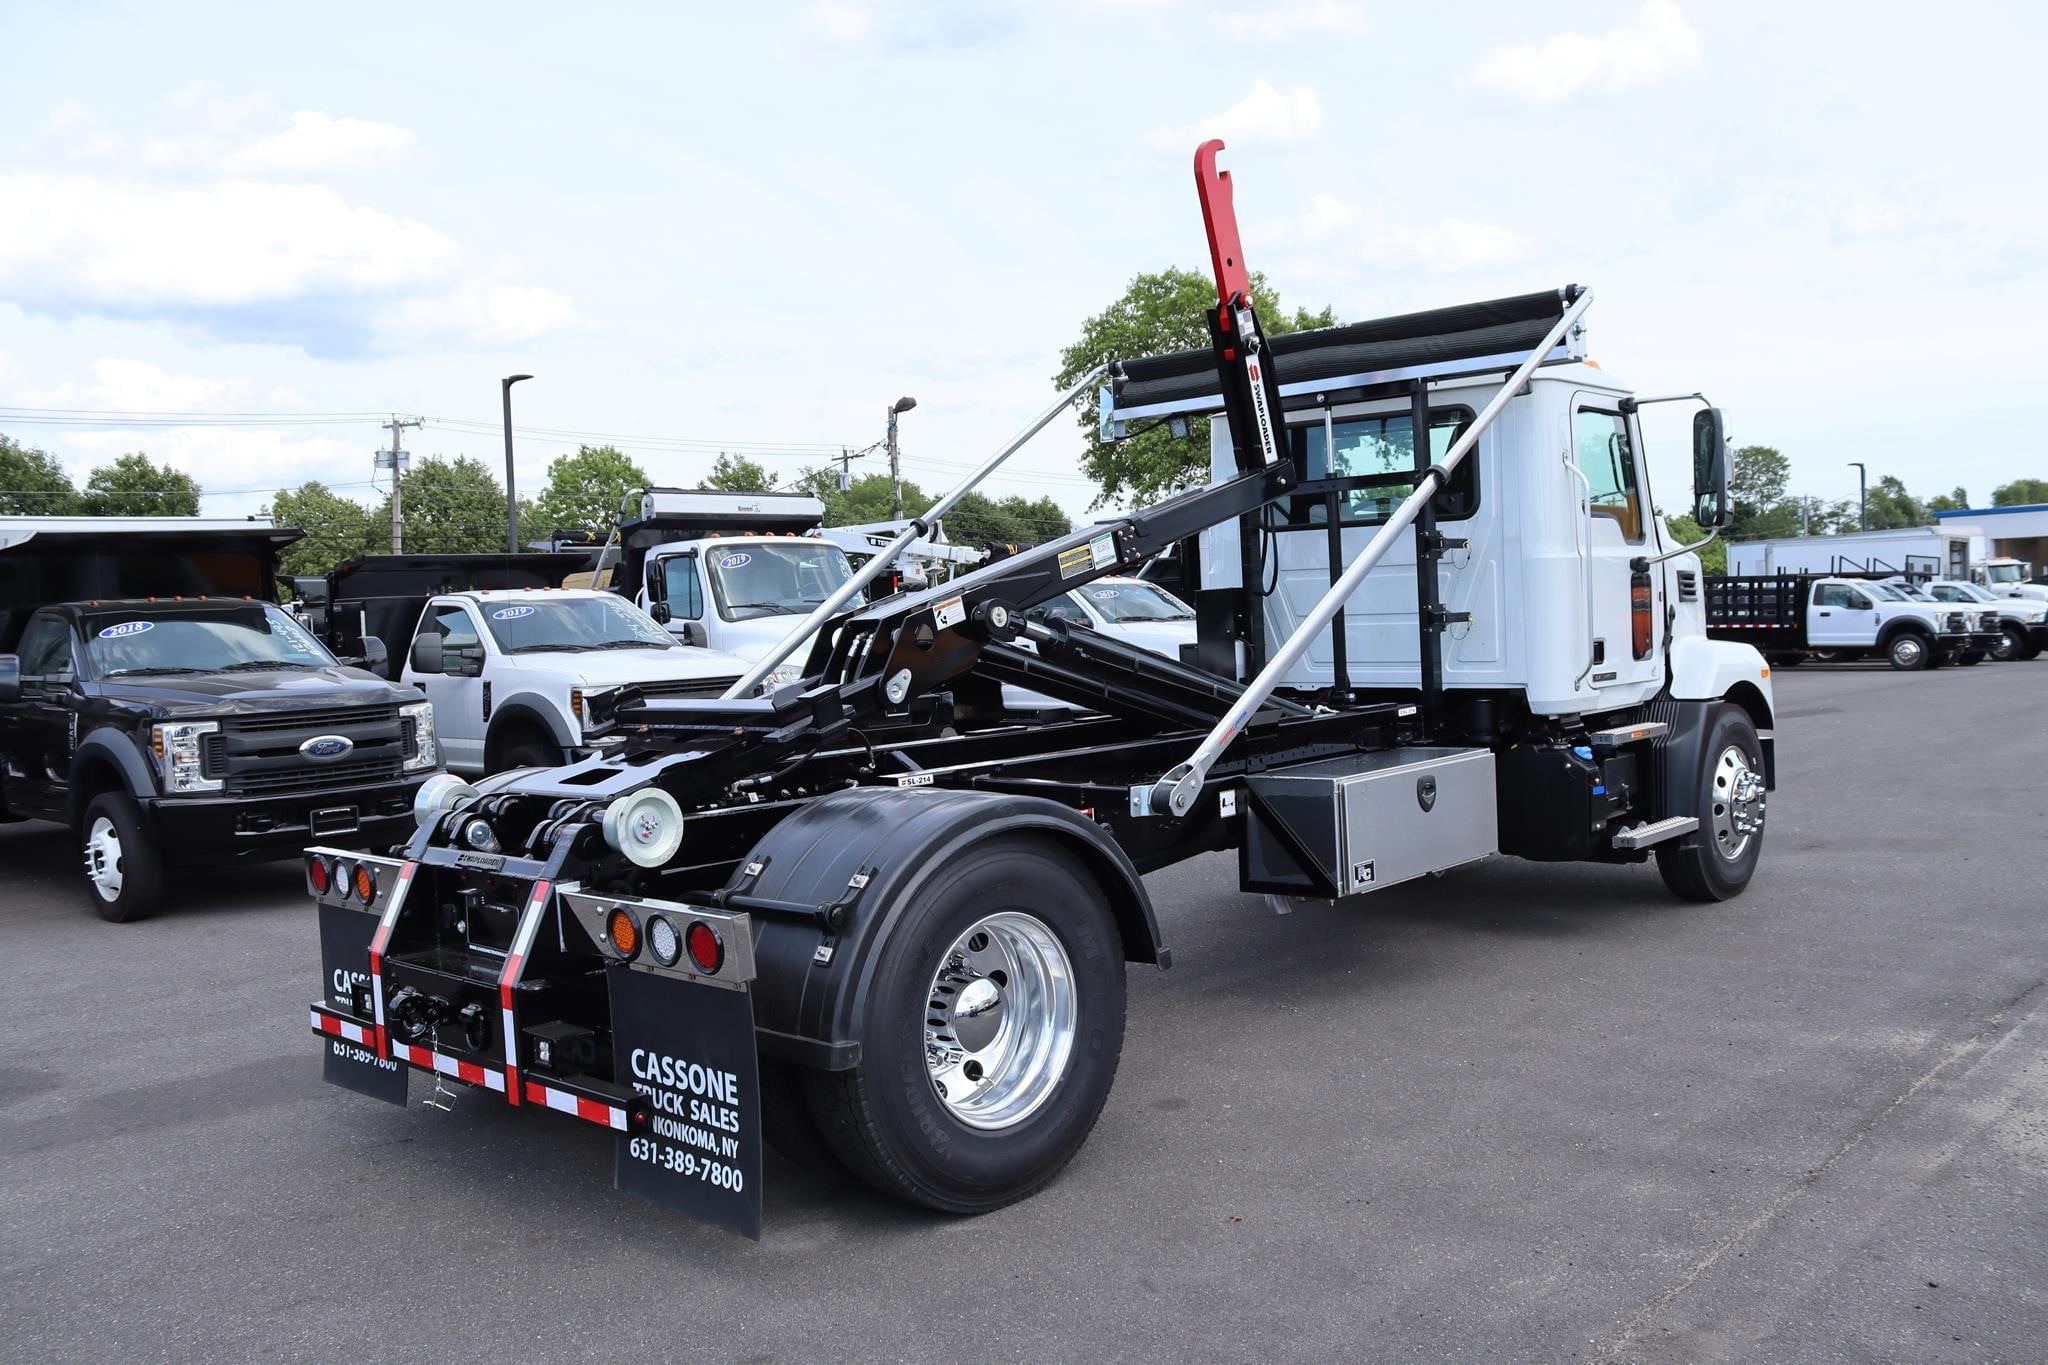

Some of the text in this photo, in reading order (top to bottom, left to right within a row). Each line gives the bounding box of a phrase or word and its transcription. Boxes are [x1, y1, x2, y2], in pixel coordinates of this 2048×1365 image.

[1254, 384, 1272, 454] SWAPLOADER
[727, 555, 746, 567] 2019
[502, 608, 527, 618] 2019
[110, 623, 143, 636] 2018
[316, 742, 340, 754] Ford
[907, 777, 931, 785] SL-214
[631, 1048, 739, 1106] CASSONE
[690, 1099, 740, 1133] SALES
[652, 1115, 739, 1159] NKONKOMA, NY
[629, 1137, 743, 1193] 631-389-7800
